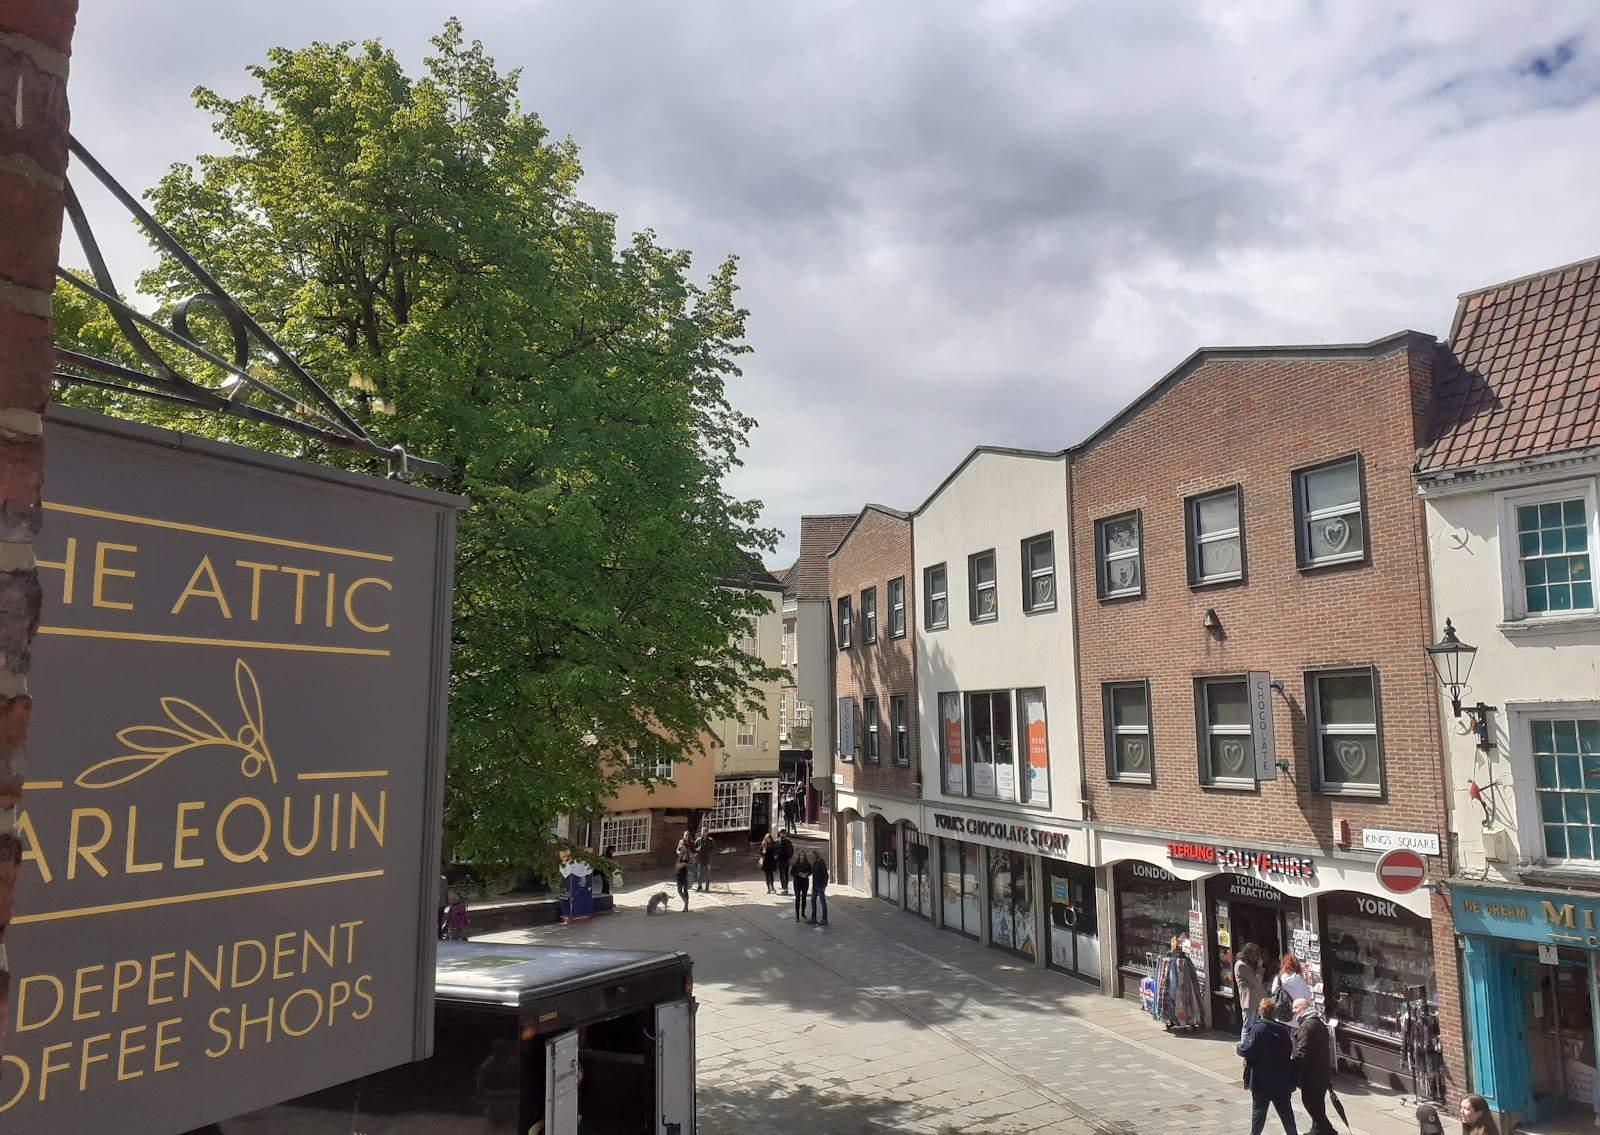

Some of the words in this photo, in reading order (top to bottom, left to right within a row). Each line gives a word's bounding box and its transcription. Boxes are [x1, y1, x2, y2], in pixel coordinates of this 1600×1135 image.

[36, 537, 138, 610] HE
[171, 554, 393, 633] ATTIC
[1257, 681, 1268, 771] CHOCOLATE
[16, 791, 387, 883] ARLEQUIN
[934, 814, 965, 833] YORK'S
[966, 819, 1029, 844] CHOCOLATE
[1031, 828, 1069, 850] STORY
[1365, 833, 1392, 845] KING'S
[1398, 836, 1436, 850] SQUARE
[1132, 864, 1176, 882] LONDON
[1167, 842, 1214, 861] STERLING
[1216, 848, 1315, 880] SOUVENIRS
[1230, 884, 1281, 901] ATRACTION
[1356, 897, 1398, 918] YORK
[1485, 903, 1527, 919] CREAM
[15, 920, 364, 1031] DEPENDENT
[0, 1016, 183, 1113] OFFEE
[205, 974, 374, 1059] SHOPS
